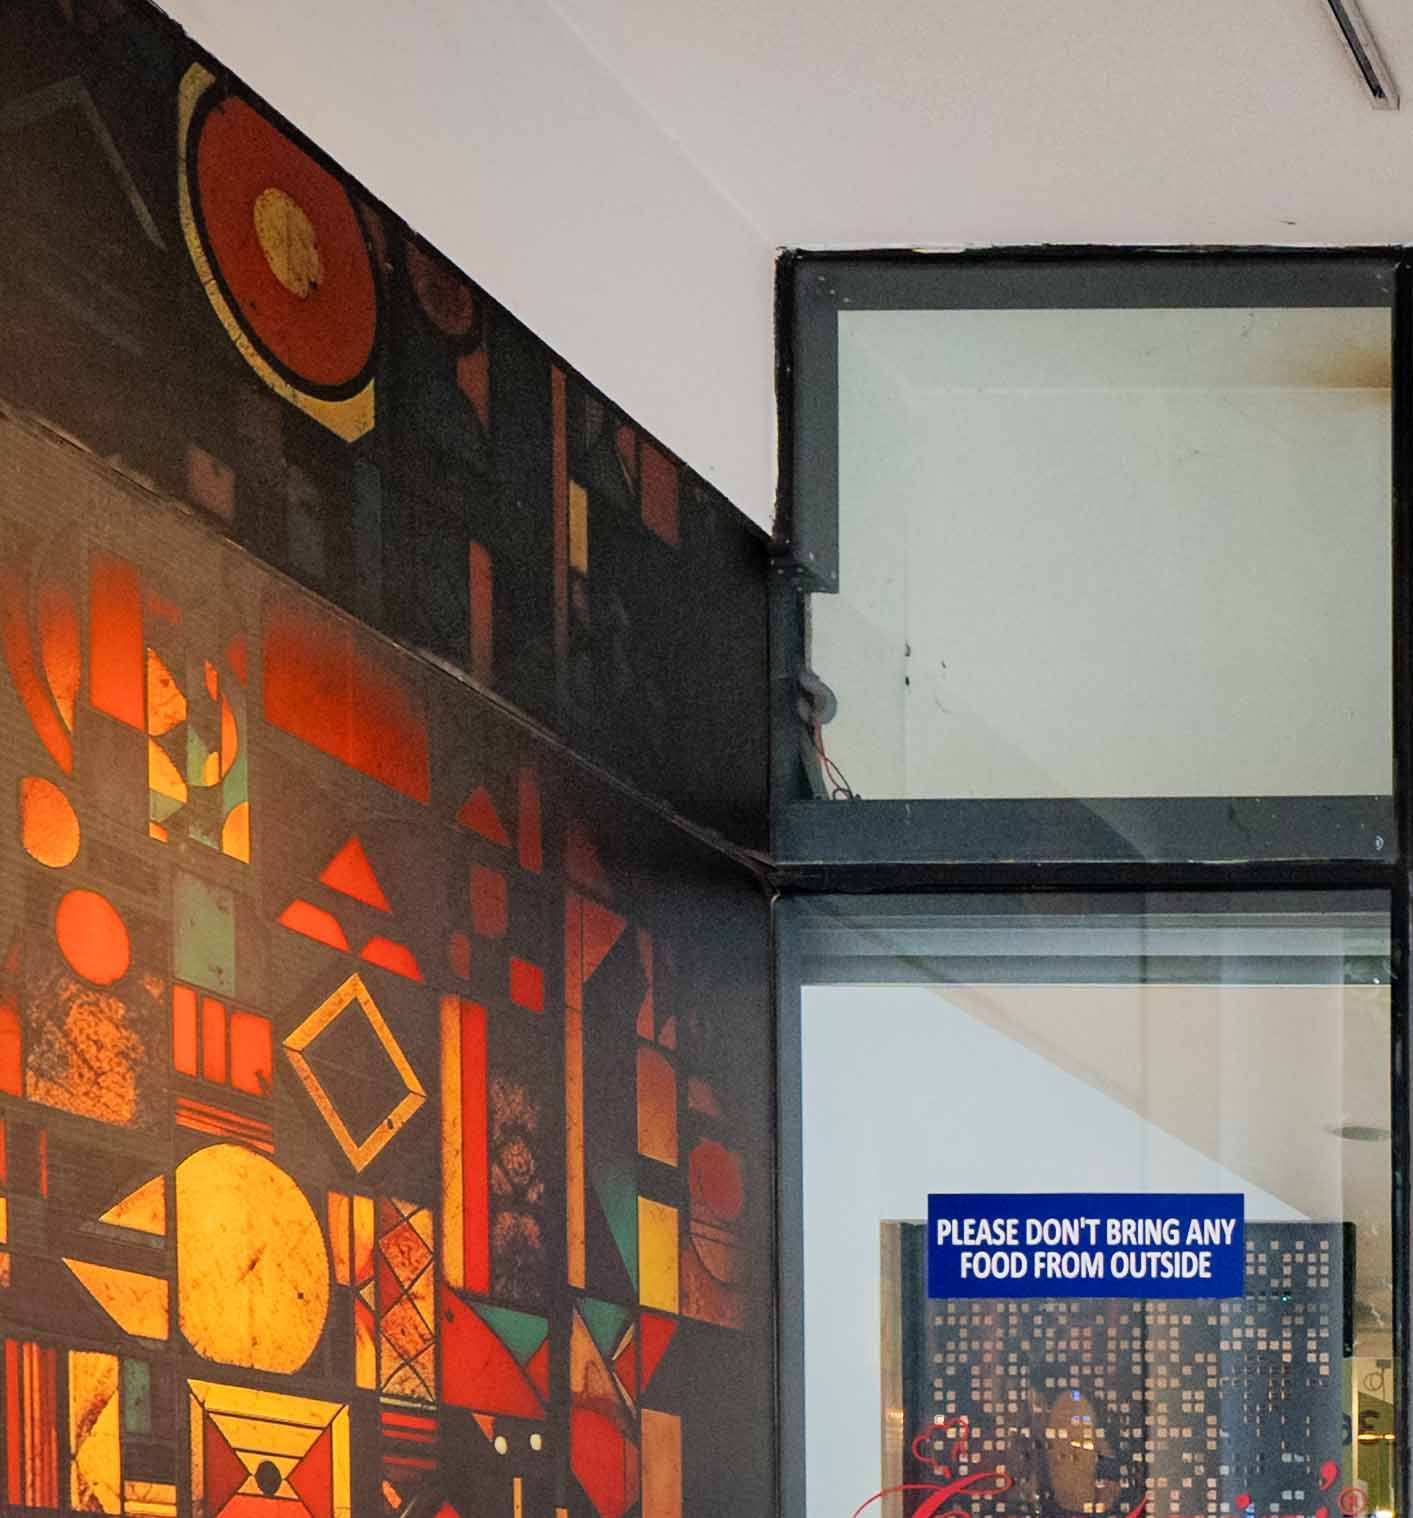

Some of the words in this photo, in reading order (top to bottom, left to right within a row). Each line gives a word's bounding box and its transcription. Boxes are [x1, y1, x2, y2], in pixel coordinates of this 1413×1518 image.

[936, 1217, 1020, 1246] PLEASE
[1025, 1217, 1101, 1246] DON'T
[1105, 1217, 1180, 1246] BRING
[1185, 1217, 1237, 1245] ANY
[959, 1251, 1028, 1279] FOOD
[1033, 1251, 1105, 1279] FROM
[1109, 1251, 1213, 1279] OUTSIDE
